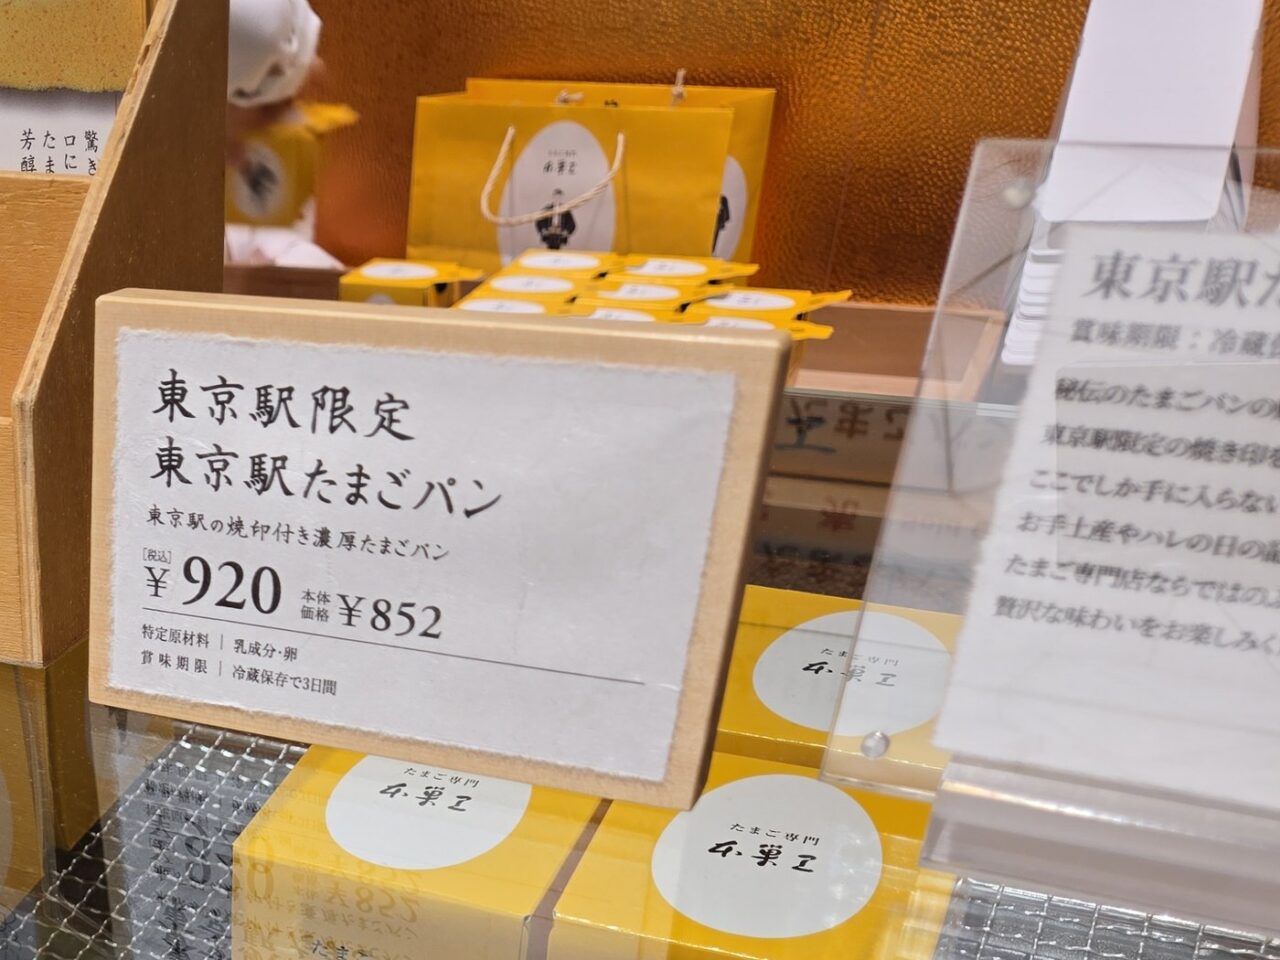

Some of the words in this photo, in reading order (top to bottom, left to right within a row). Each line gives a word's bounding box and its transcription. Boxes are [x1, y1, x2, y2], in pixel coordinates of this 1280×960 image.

[152, 368, 415, 441] 東京駅限定
[150, 435, 502, 519] 東京駅たまごパン
[147, 505, 450, 562] 東京駅の焼印付き濃厚たまごパン
[141, 624, 210, 648] 特定原材料
[337, 593, 442, 640] ¥852
[141, 649, 208, 674] 賞味期限
[232, 664, 337, 697] 冷蔵保存で3日間
